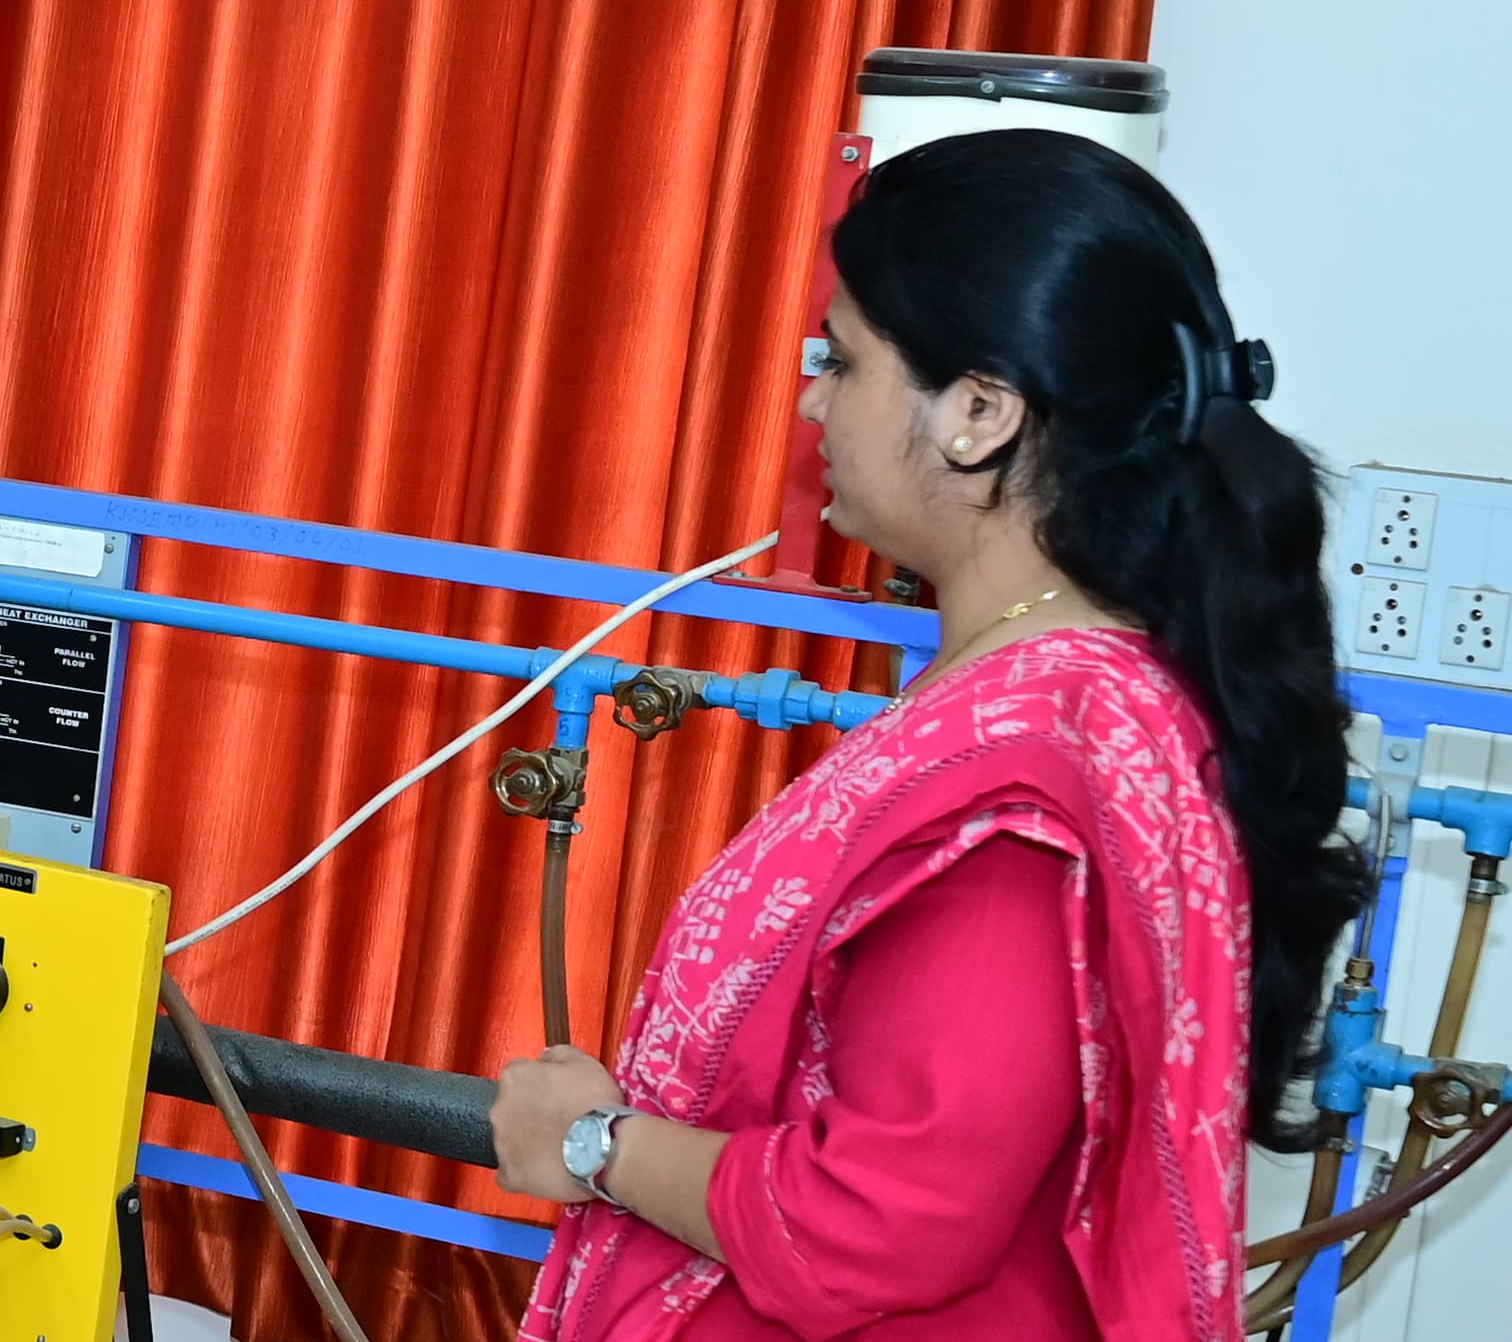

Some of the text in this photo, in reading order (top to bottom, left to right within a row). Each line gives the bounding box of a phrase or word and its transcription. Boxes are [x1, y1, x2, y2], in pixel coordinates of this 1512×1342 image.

[24, 611, 88, 629] EXCHANGER
[54, 647, 96, 660] PARALLEL
[62, 658, 86, 668] FLOW
[48, 706, 89, 719] COUNTER
[56, 717, 80, 727] FLOW
